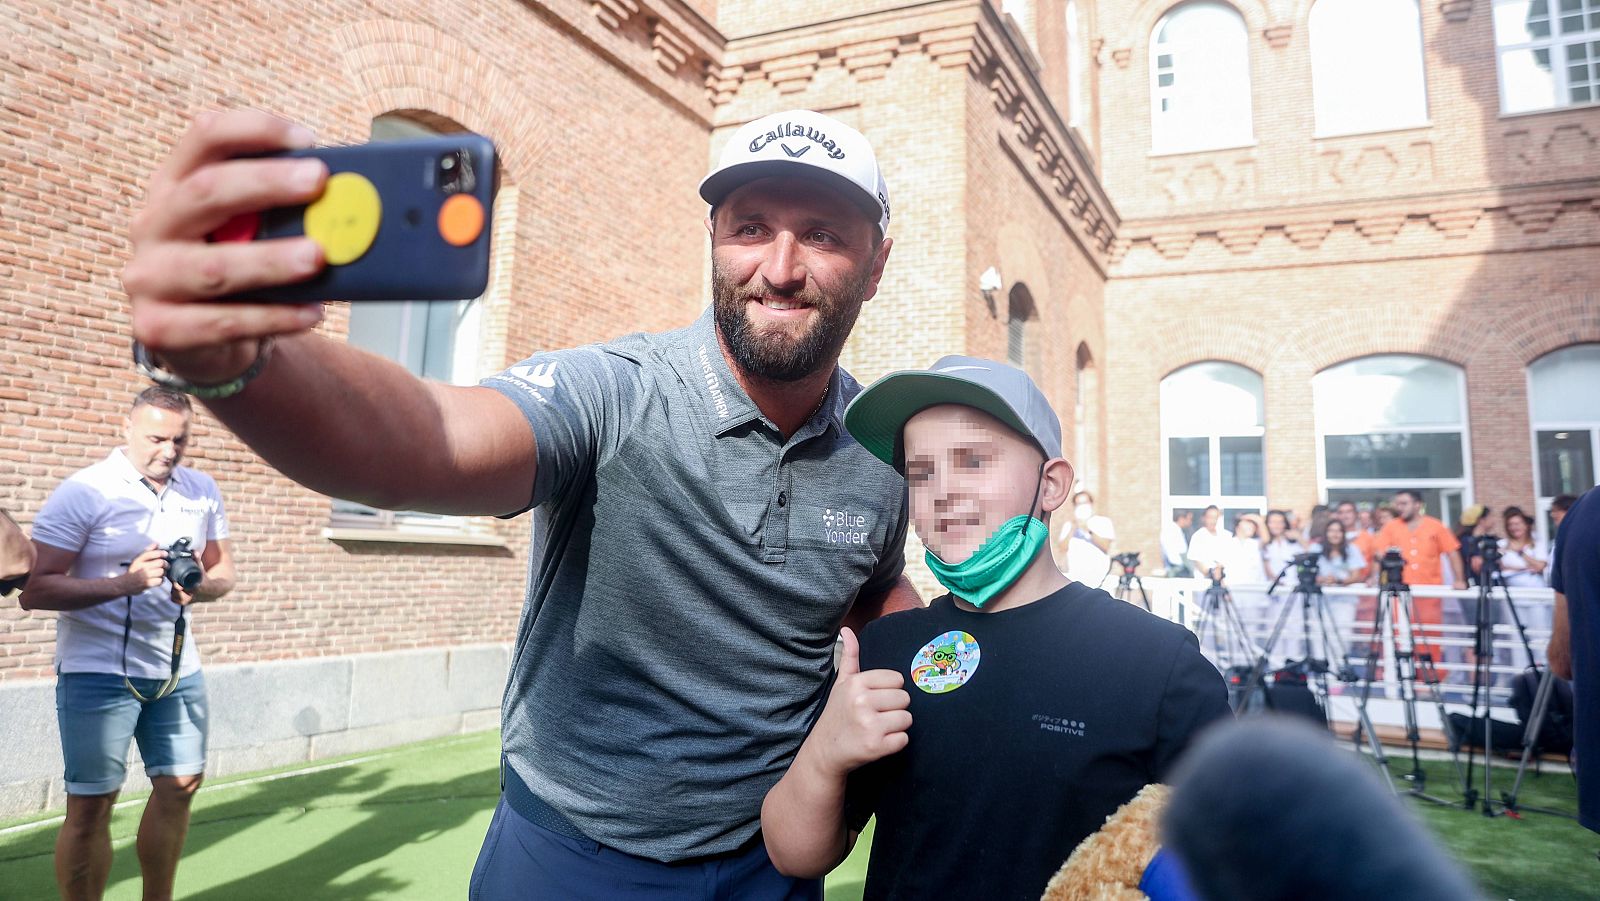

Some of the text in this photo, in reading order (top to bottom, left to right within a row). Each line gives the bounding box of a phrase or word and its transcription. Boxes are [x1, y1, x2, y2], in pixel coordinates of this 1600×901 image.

[748, 121, 846, 160] Callaway
[836, 511, 865, 527] Blue
[824, 528, 868, 544] Yonder
[1040, 723, 1084, 737] POSITIVE
